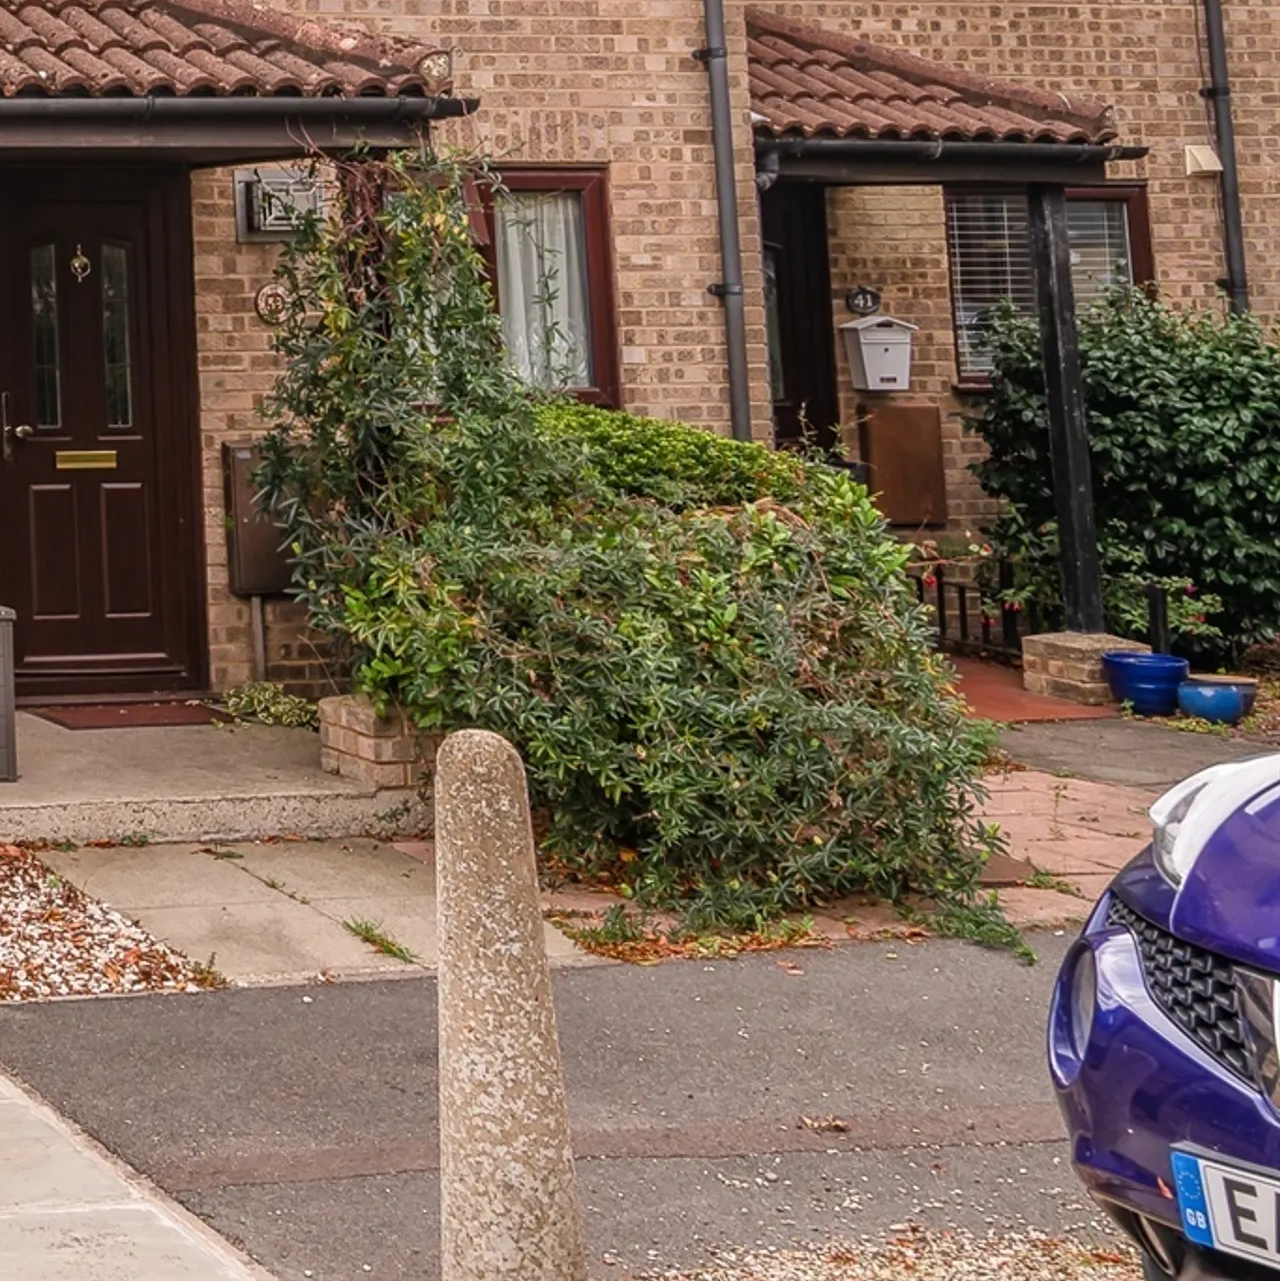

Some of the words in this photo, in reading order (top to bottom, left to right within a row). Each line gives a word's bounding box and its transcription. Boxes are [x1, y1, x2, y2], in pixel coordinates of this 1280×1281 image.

[854, 294, 873, 307] 41
[1185, 1207, 1207, 1230] GB
[1222, 1177, 1280, 1254] E
